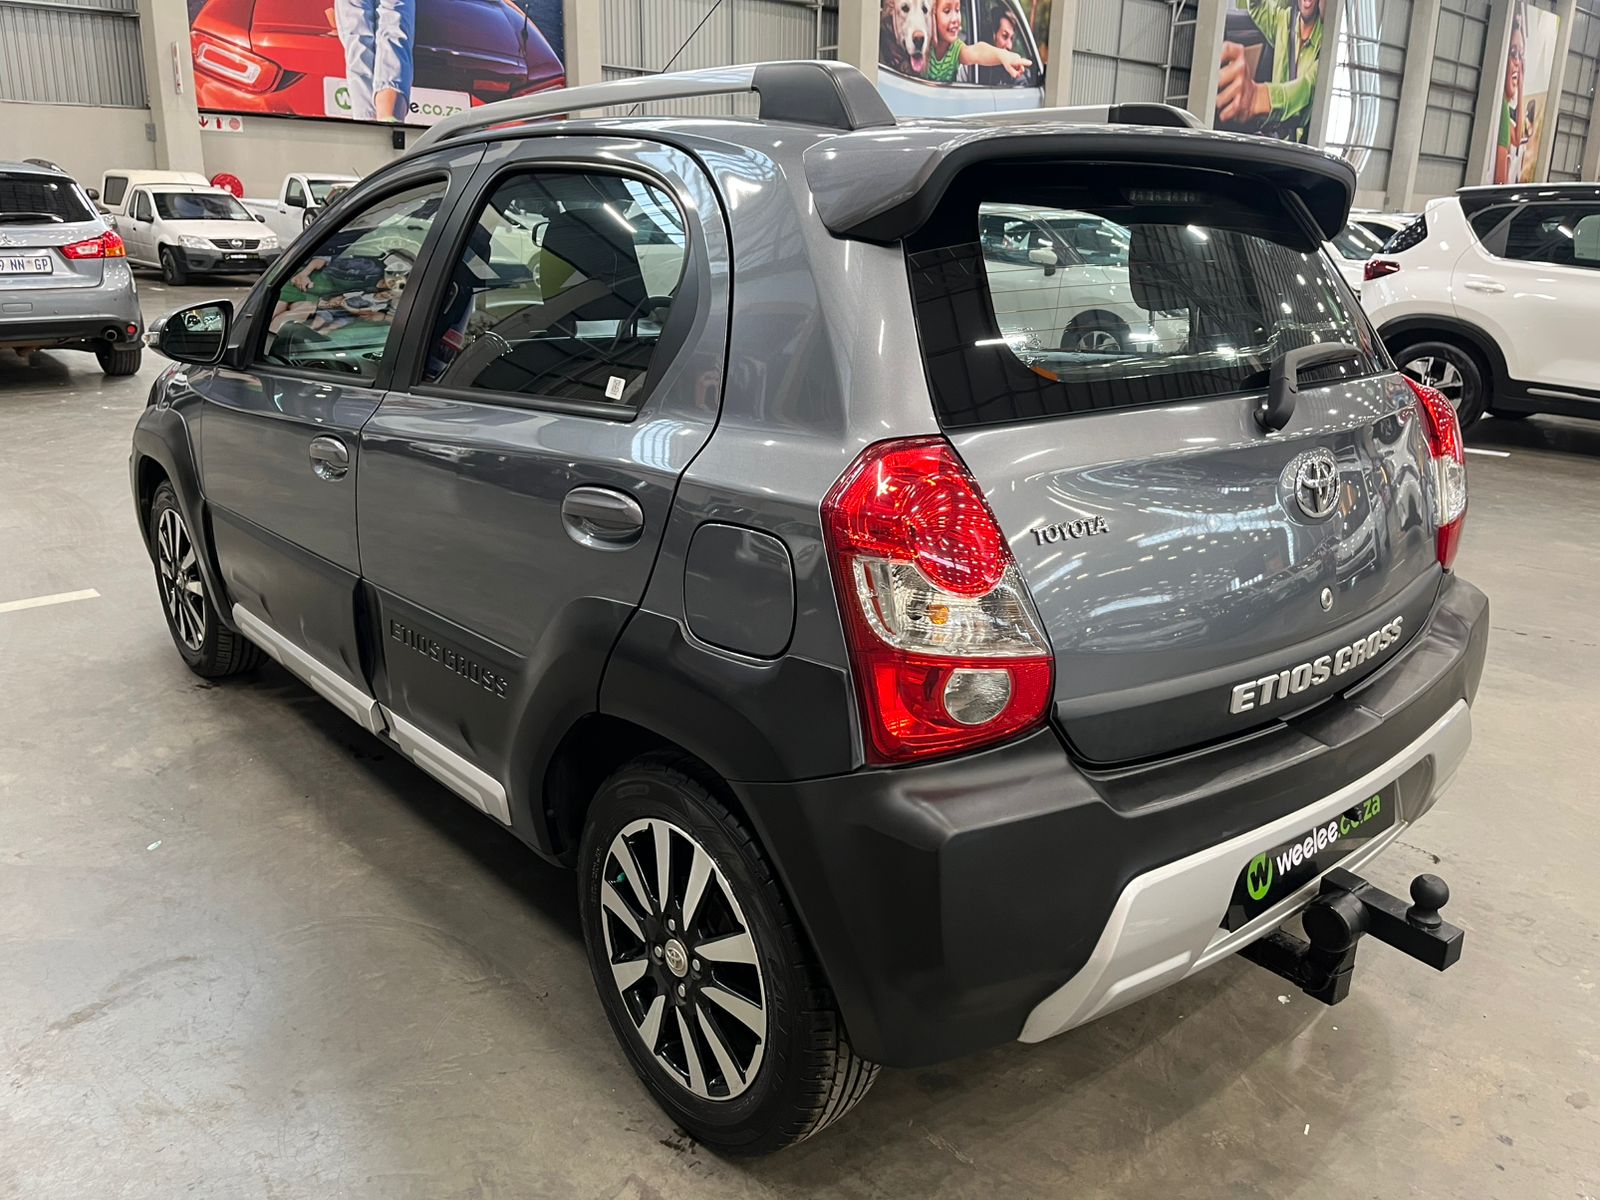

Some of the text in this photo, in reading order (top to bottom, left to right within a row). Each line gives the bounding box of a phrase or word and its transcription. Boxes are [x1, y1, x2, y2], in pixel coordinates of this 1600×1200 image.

[10, 259, 25, 271] NN
[34, 258, 48, 271] GP
[1030, 516, 1110, 546] TOYOTA
[390, 619, 507, 699] ETIOS CROSS
[1229, 615, 1404, 714] ETIOS CROSS
